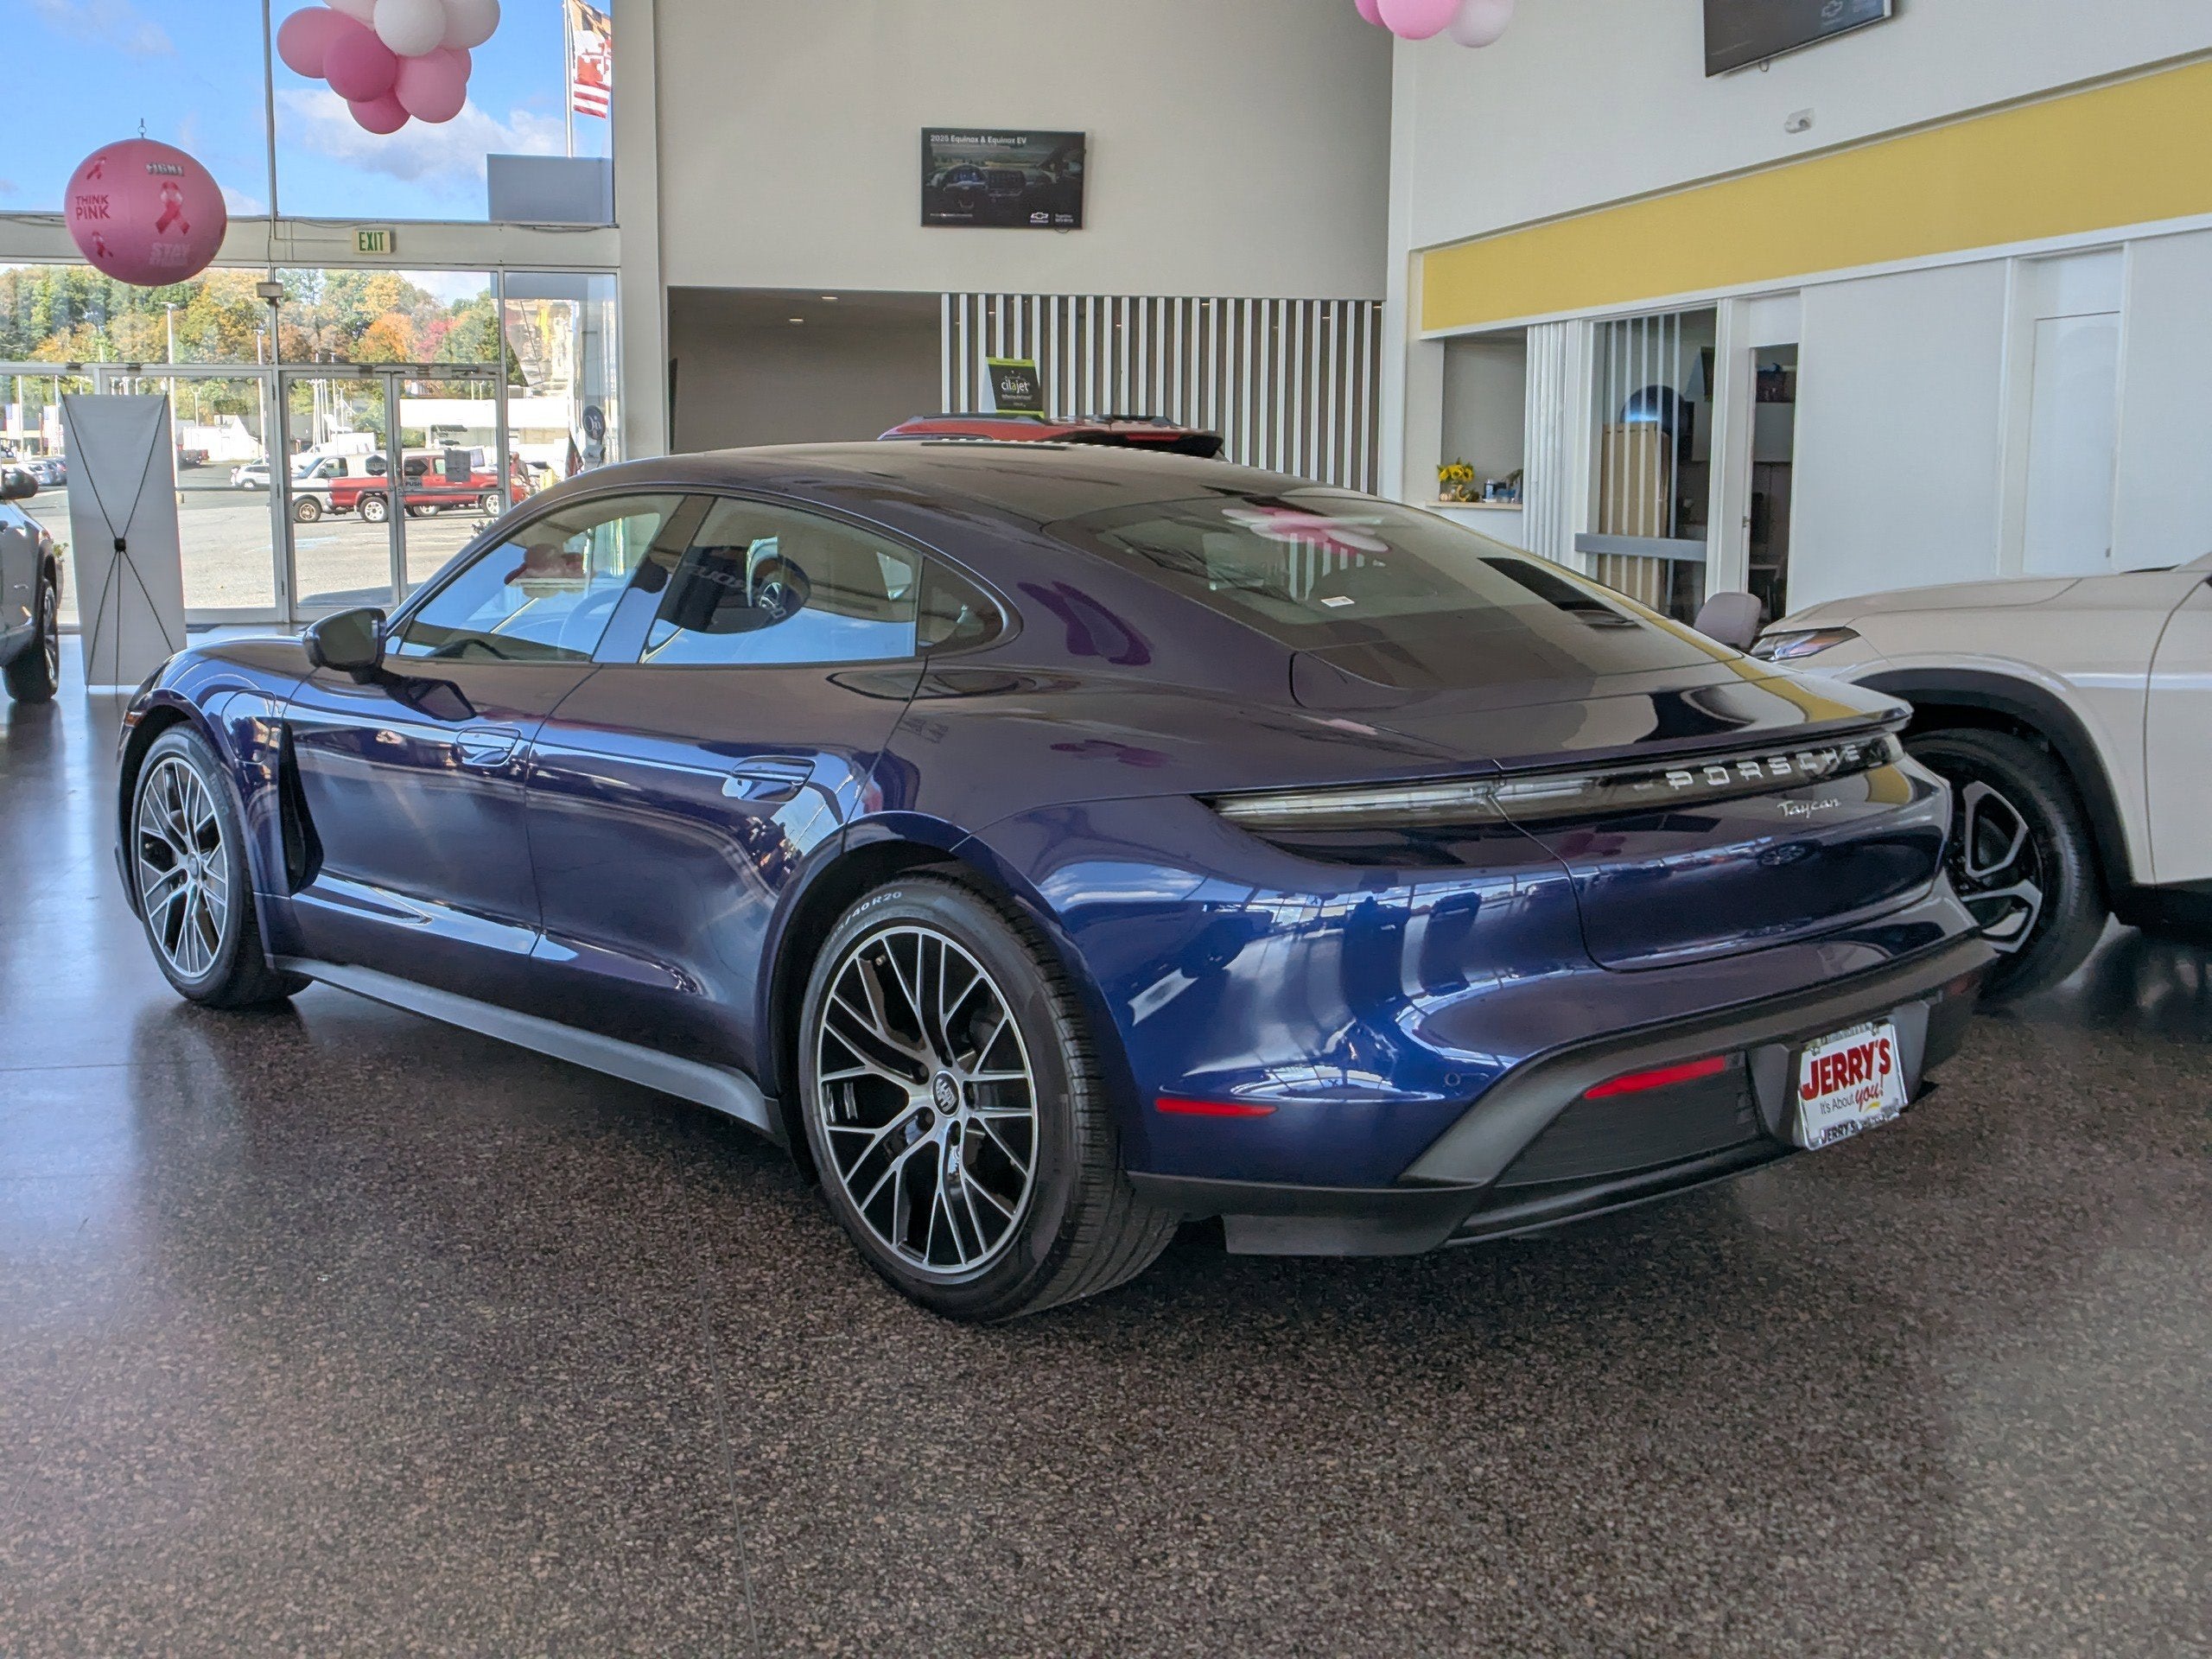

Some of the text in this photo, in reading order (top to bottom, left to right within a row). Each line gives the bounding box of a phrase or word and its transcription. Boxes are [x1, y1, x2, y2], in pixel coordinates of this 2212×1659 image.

[950, 135, 979, 143] Equinox
[988, 136, 1015, 144] Equinox
[74, 194, 109, 206] THINK
[75, 206, 111, 220] PINK
[359, 232, 385, 251] EXIT
[1001, 375, 1029, 393] cilajet
[1665, 744, 1860, 790] PORSCHE
[1777, 797, 1842, 818] Taycan
[1801, 1038, 1891, 1101] JERRY'S
[1832, 1094, 1855, 1112] About
